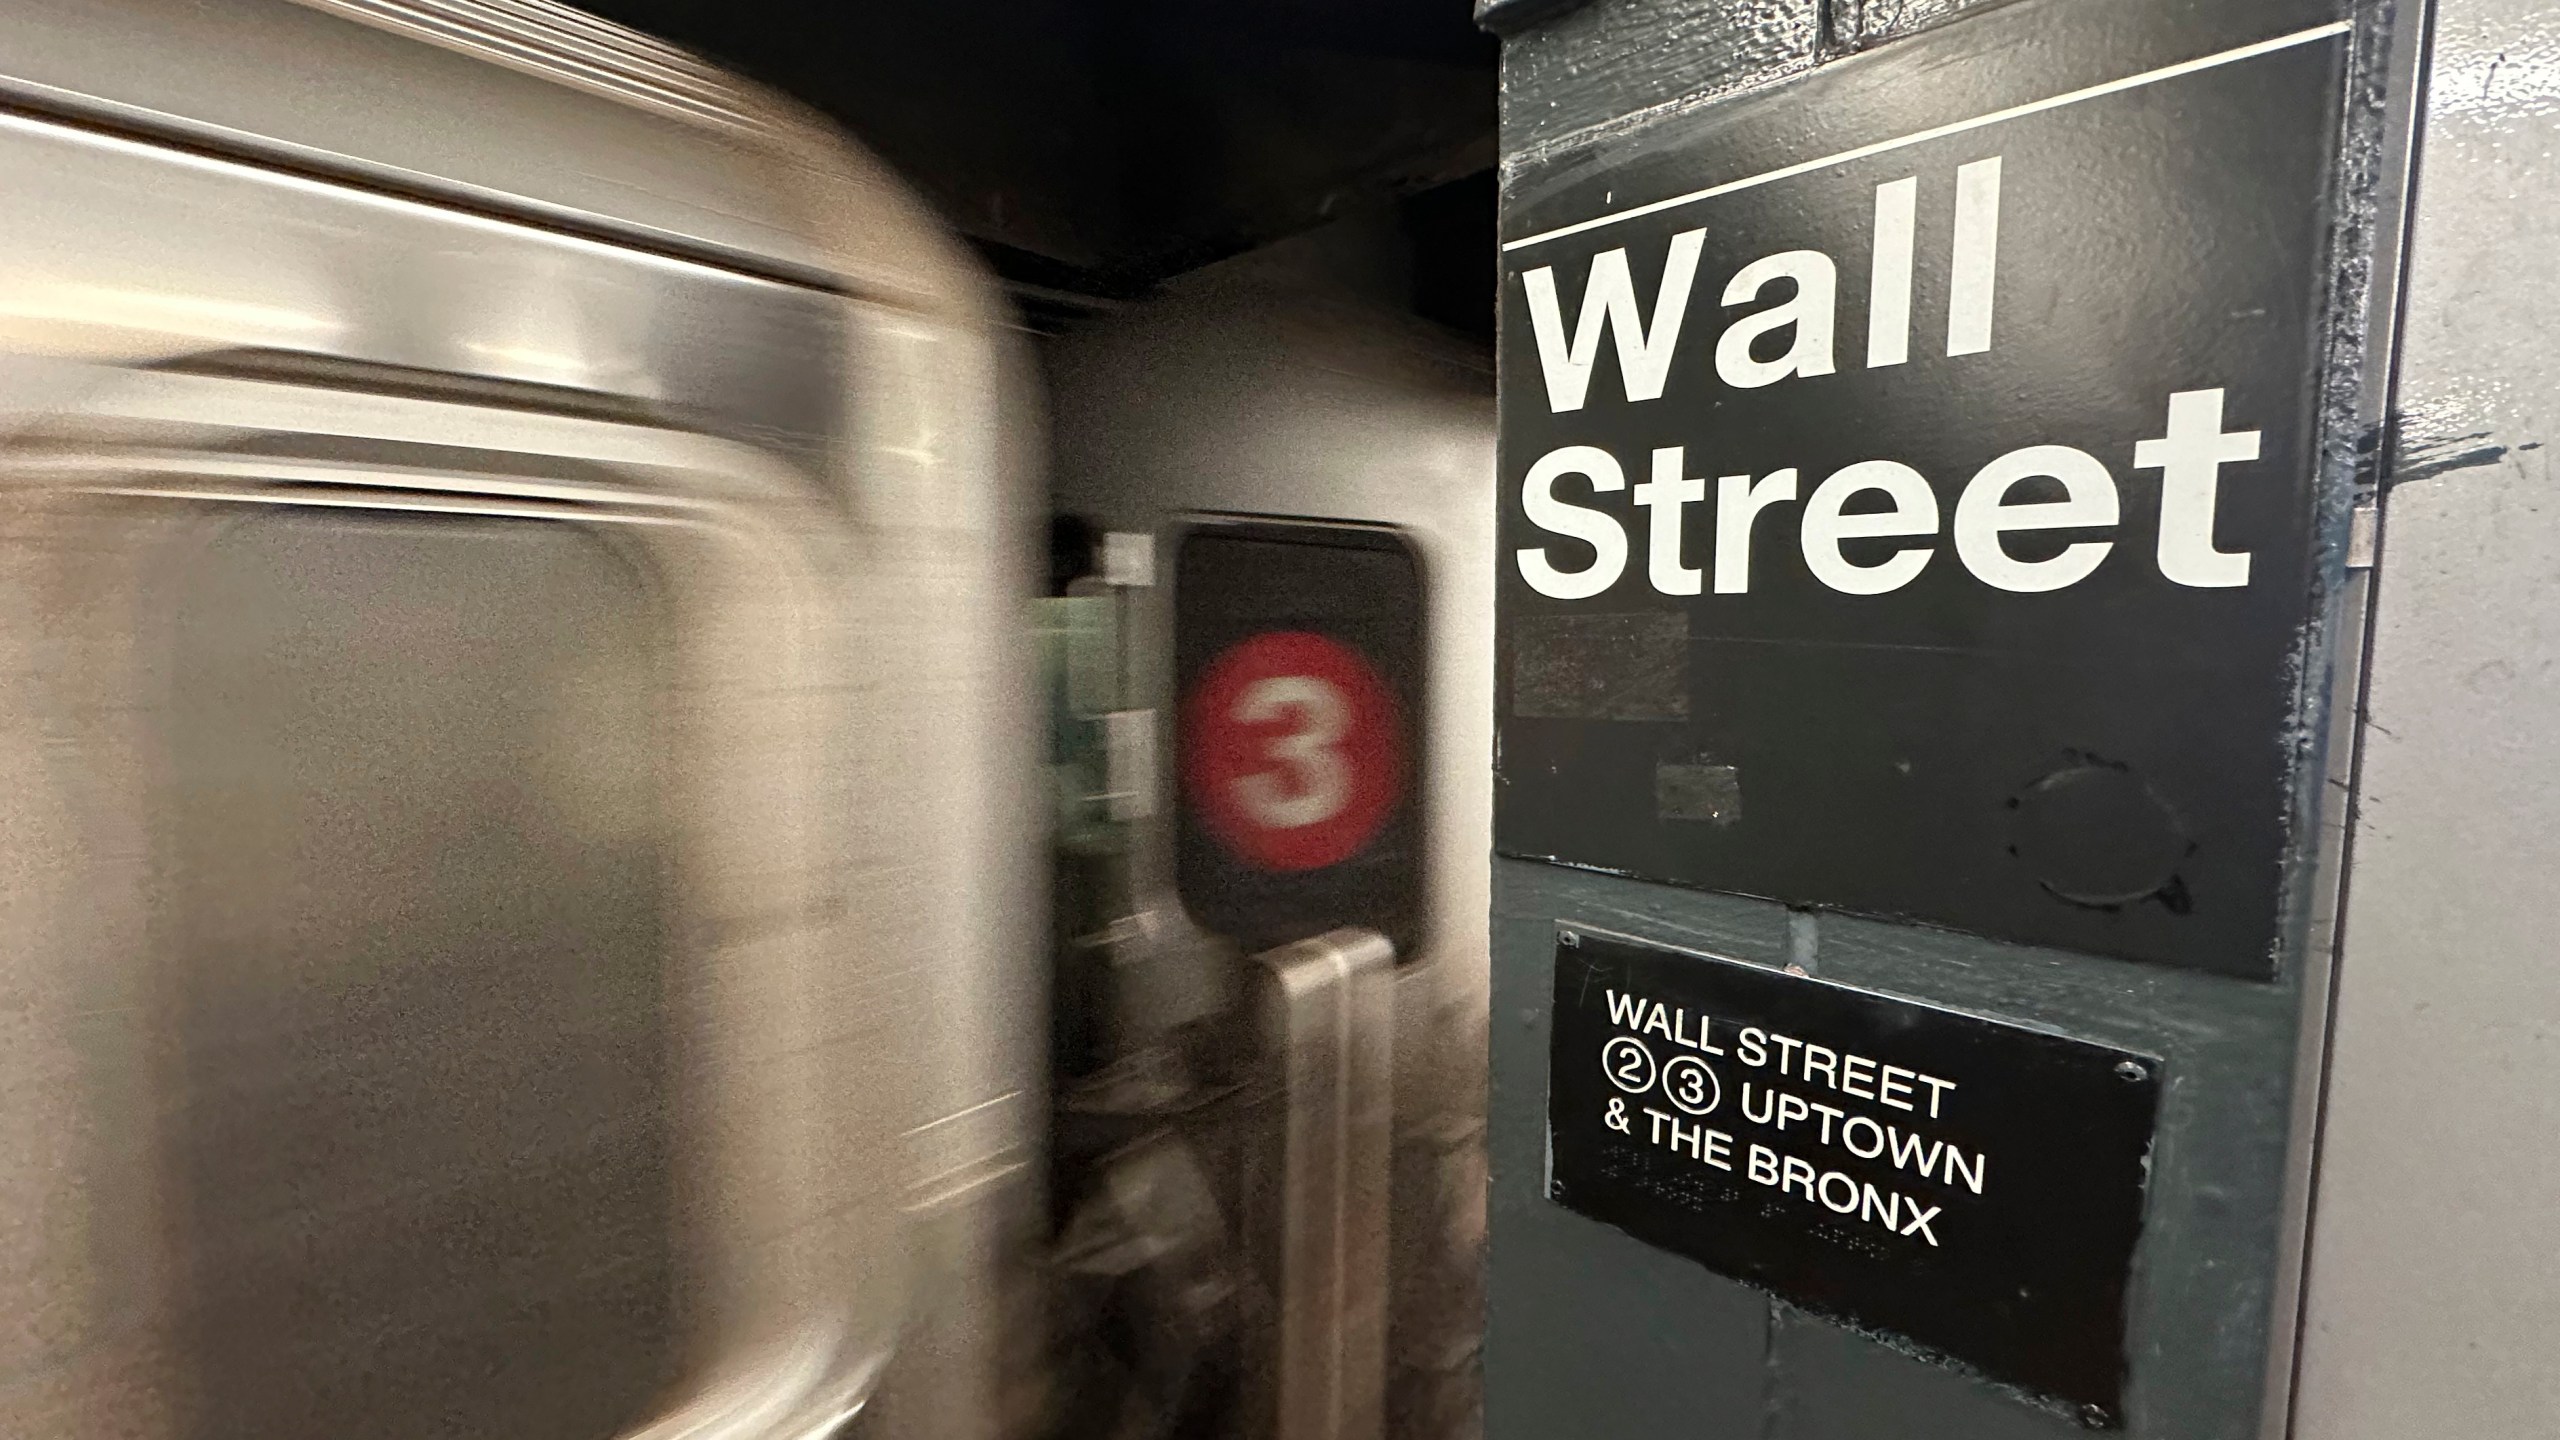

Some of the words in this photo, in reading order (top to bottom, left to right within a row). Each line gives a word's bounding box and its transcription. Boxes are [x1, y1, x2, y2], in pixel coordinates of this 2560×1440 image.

[1521, 156, 2002, 413] Wall
[1516, 387, 2262, 600] Street
[1231, 674, 1353, 829] 3
[1606, 989, 1724, 1057] WALL
[1737, 1027, 1957, 1119] STREET
[1604, 1097, 1631, 1136] &
[1643, 1107, 1734, 1172] THE
[1748, 1143, 1942, 1247] BRONX
[1741, 1082, 1985, 1195] UPTOWN
